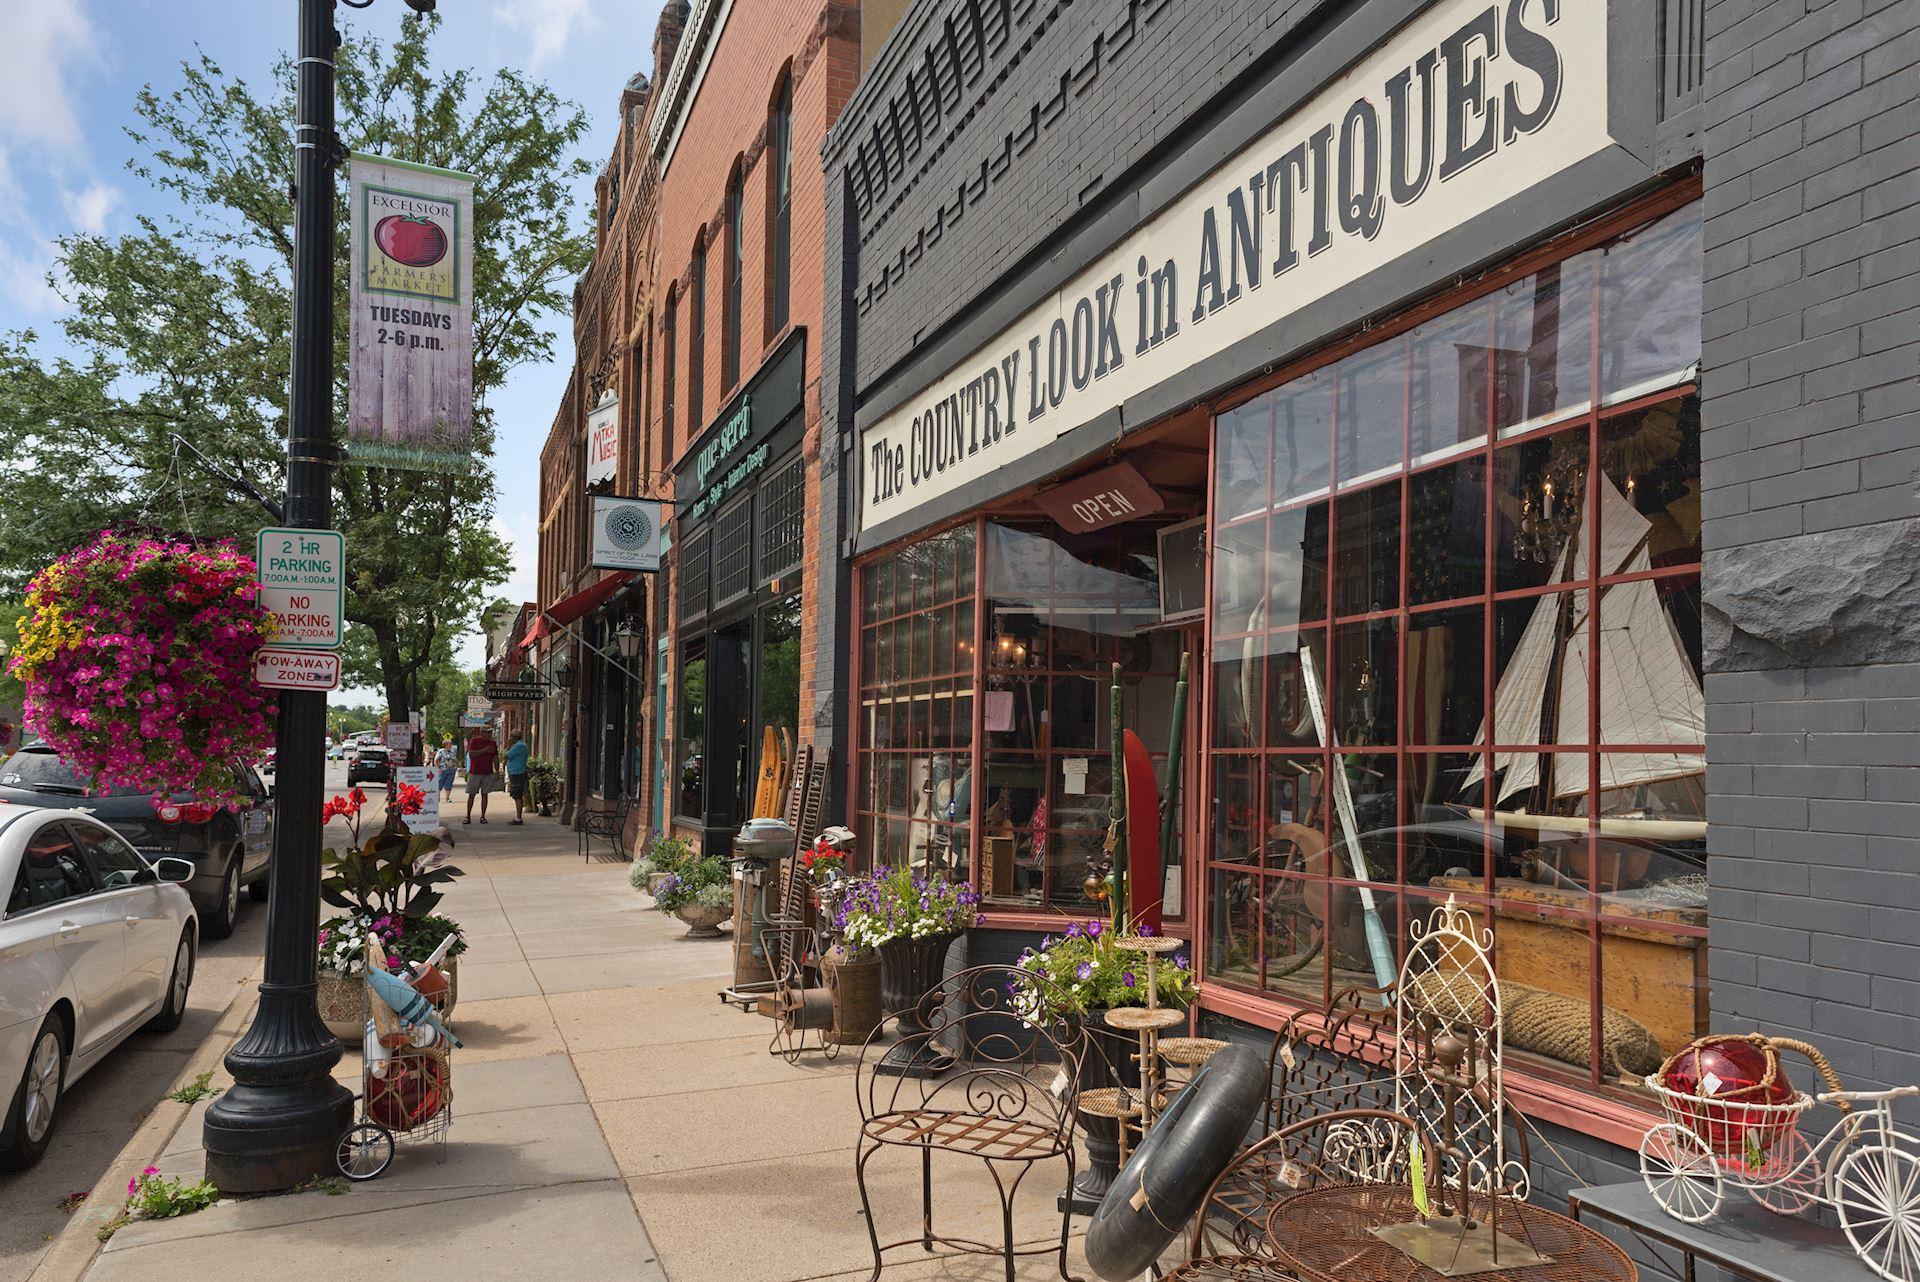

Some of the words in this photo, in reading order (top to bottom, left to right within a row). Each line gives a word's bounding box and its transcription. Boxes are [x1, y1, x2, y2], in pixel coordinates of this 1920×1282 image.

[373, 195, 450, 217] EXCELSIOR
[872, 437, 904, 507] The
[910, 349, 1021, 488] COUNTRY
[1028, 273, 1125, 423] LOOK
[1136, 255, 1179, 359] in
[1192, 0, 1563, 325] ANTIQUES
[377, 277, 441, 293] MARKET
[370, 305, 451, 330] TUESDAYS
[378, 328, 405, 346] 2-6
[410, 334, 444, 351] p.m.
[697, 438, 720, 491] que
[720, 394, 751, 459] será
[710, 483, 723, 506] Style
[728, 462, 747, 490] Interior
[746, 443, 769, 474] Design
[1072, 489, 1136, 523] OPEN
[282, 541, 292, 554] 2
[301, 541, 320, 555] HR
[270, 558, 331, 573] PARKING
[290, 596, 310, 609] NO
[263, 656, 333, 669] TOW-AWAY
[278, 671, 314, 681] ZONE
[486, 691, 545, 699] BRIGHTWATER
